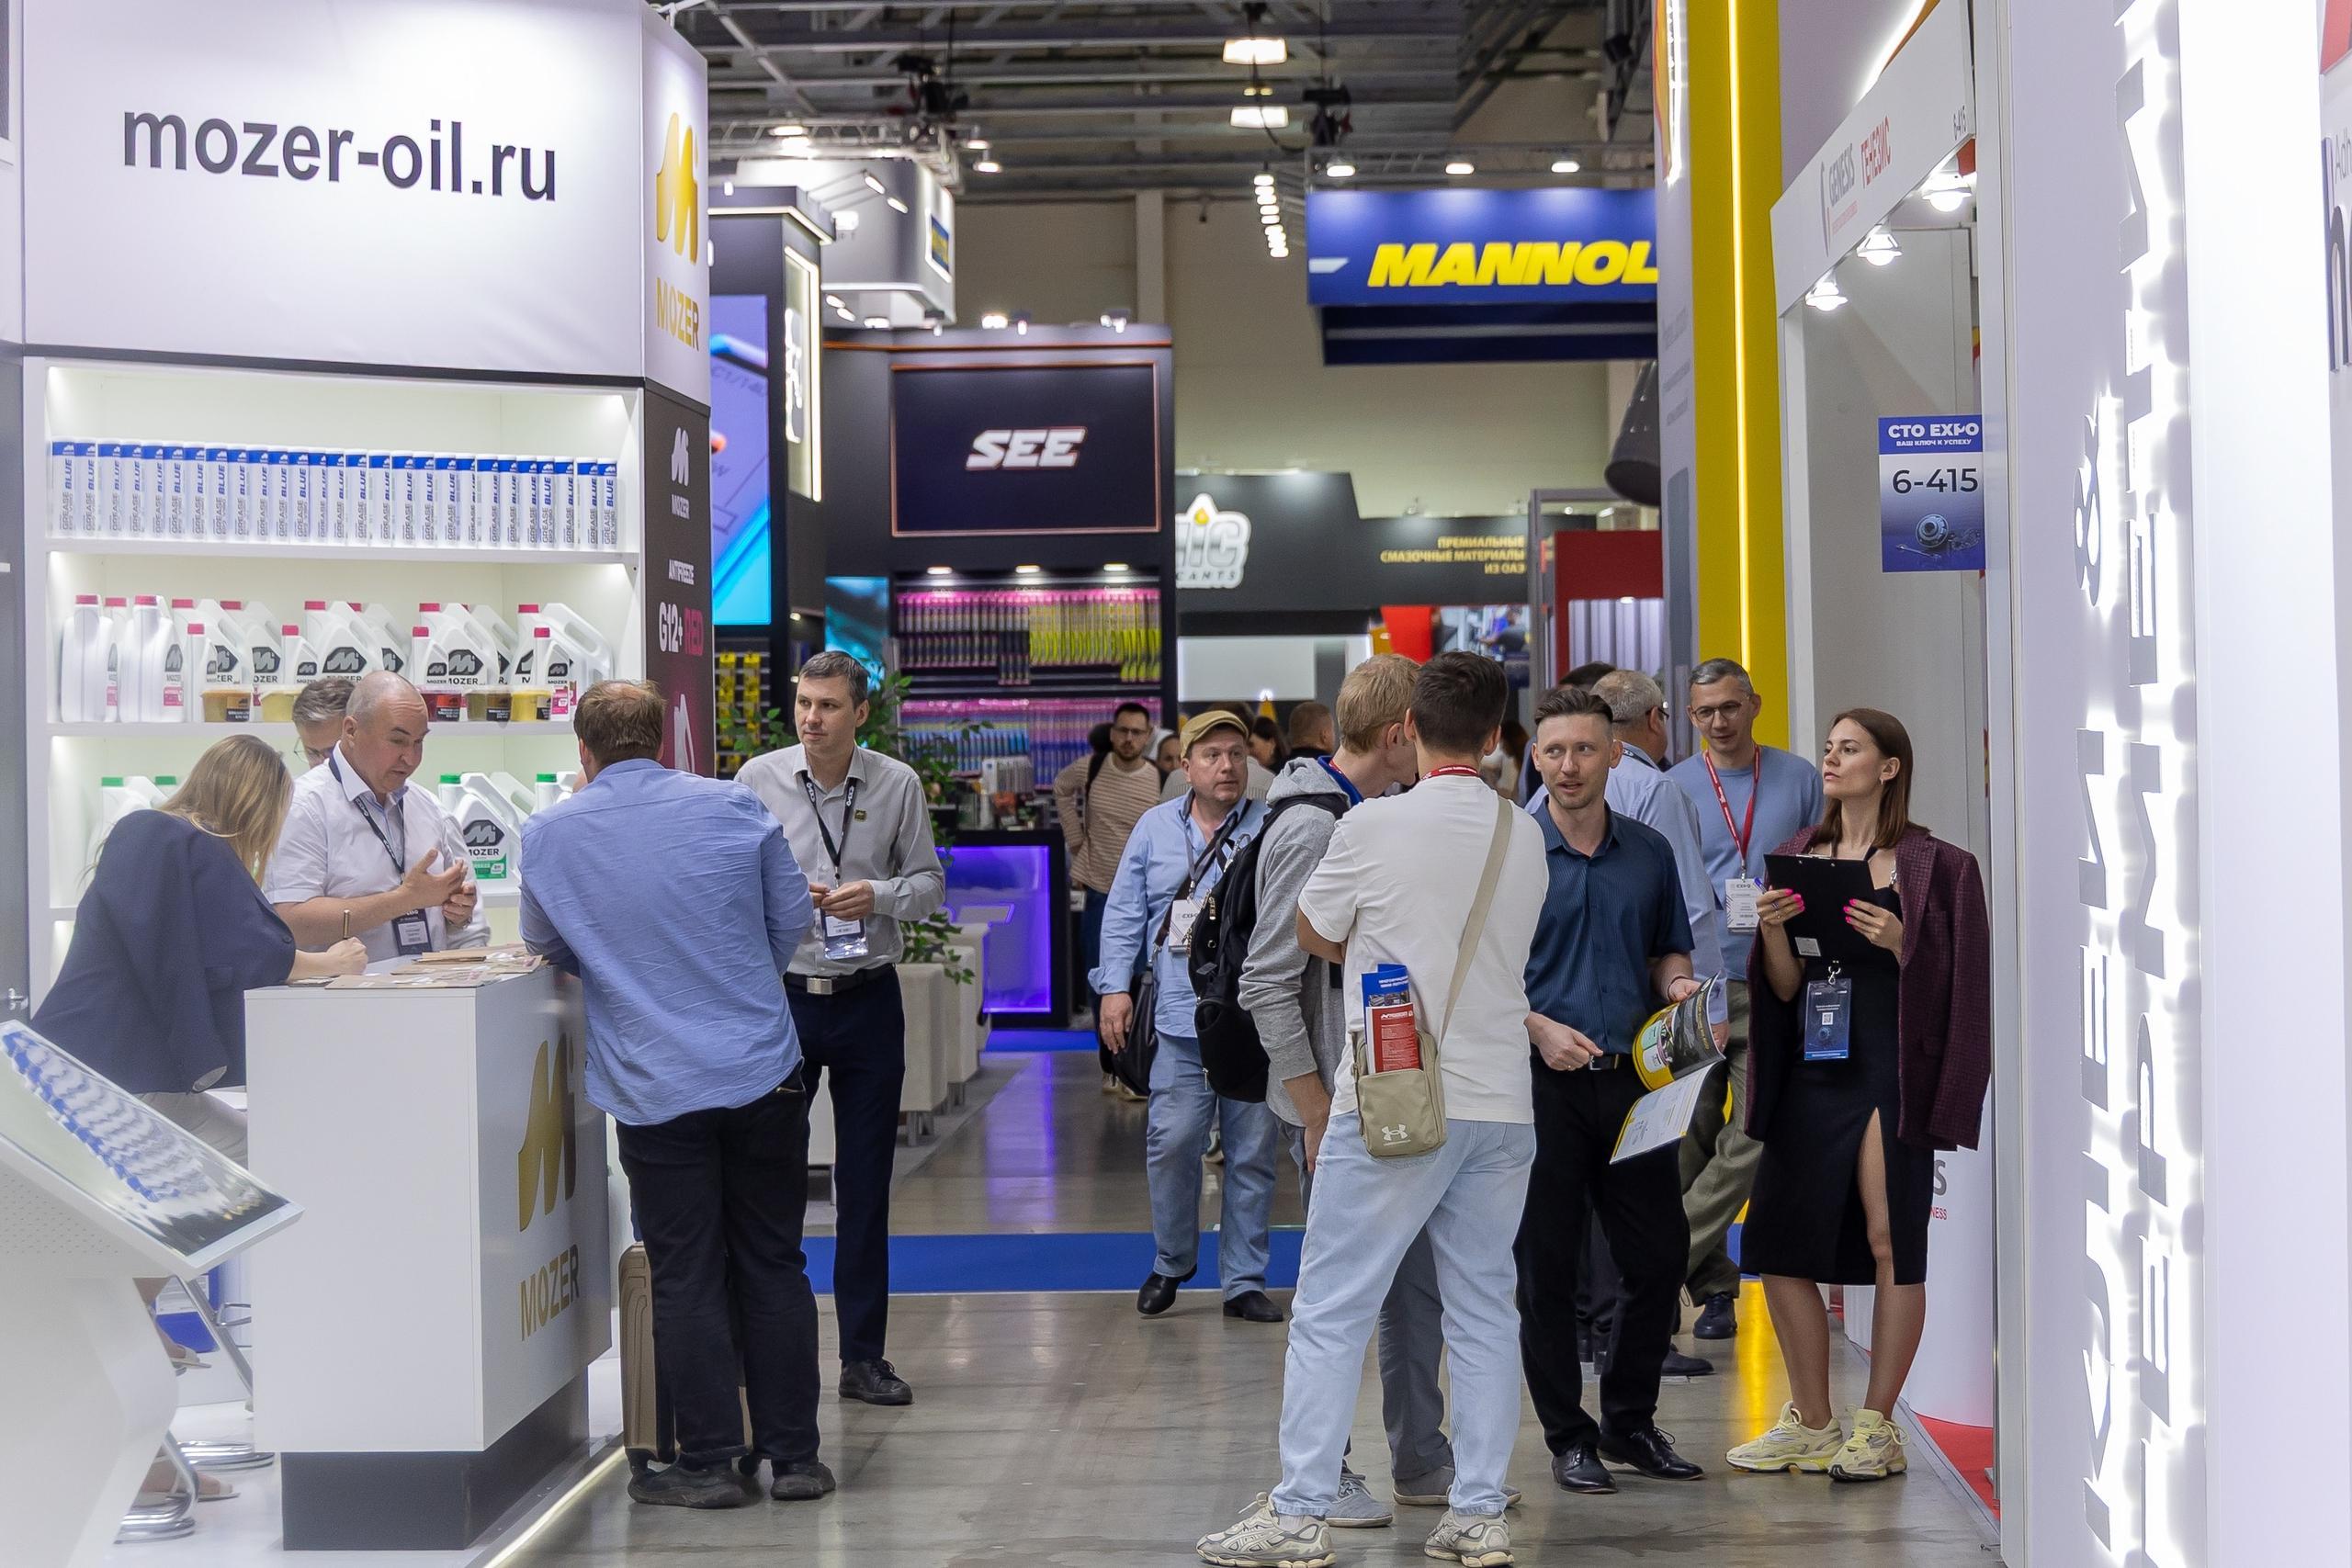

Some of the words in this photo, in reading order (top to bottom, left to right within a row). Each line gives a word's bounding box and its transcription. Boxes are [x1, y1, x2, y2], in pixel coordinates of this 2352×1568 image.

[123, 110, 556, 201] mozer-oil.ru
[1367, 241, 1658, 288] MANNOL
[656, 277, 699, 351] MOZER
[1930, 423, 1979, 436] EXPO
[965, 426, 1087, 470] SEE
[1893, 468, 1978, 493] 6-415
[1380, 549, 1453, 562] СМАЗОЧНЫЕ
[1454, 548, 1525, 561] МАТЕРИАЛЫ
[1438, 536, 1525, 548] ПРЕМИАЛЬНЫЕ
[1176, 571, 1236, 581] CANTS
[659, 602, 684, 652] G12+
[684, 607, 704, 656] RED
[253, 674, 277, 682] OZER
[2113, 0, 2171, 1568] ГЕРМЕТИ
[1930, 1206, 1947, 1220] NESS
[520, 1244, 579, 1341] MOZER
